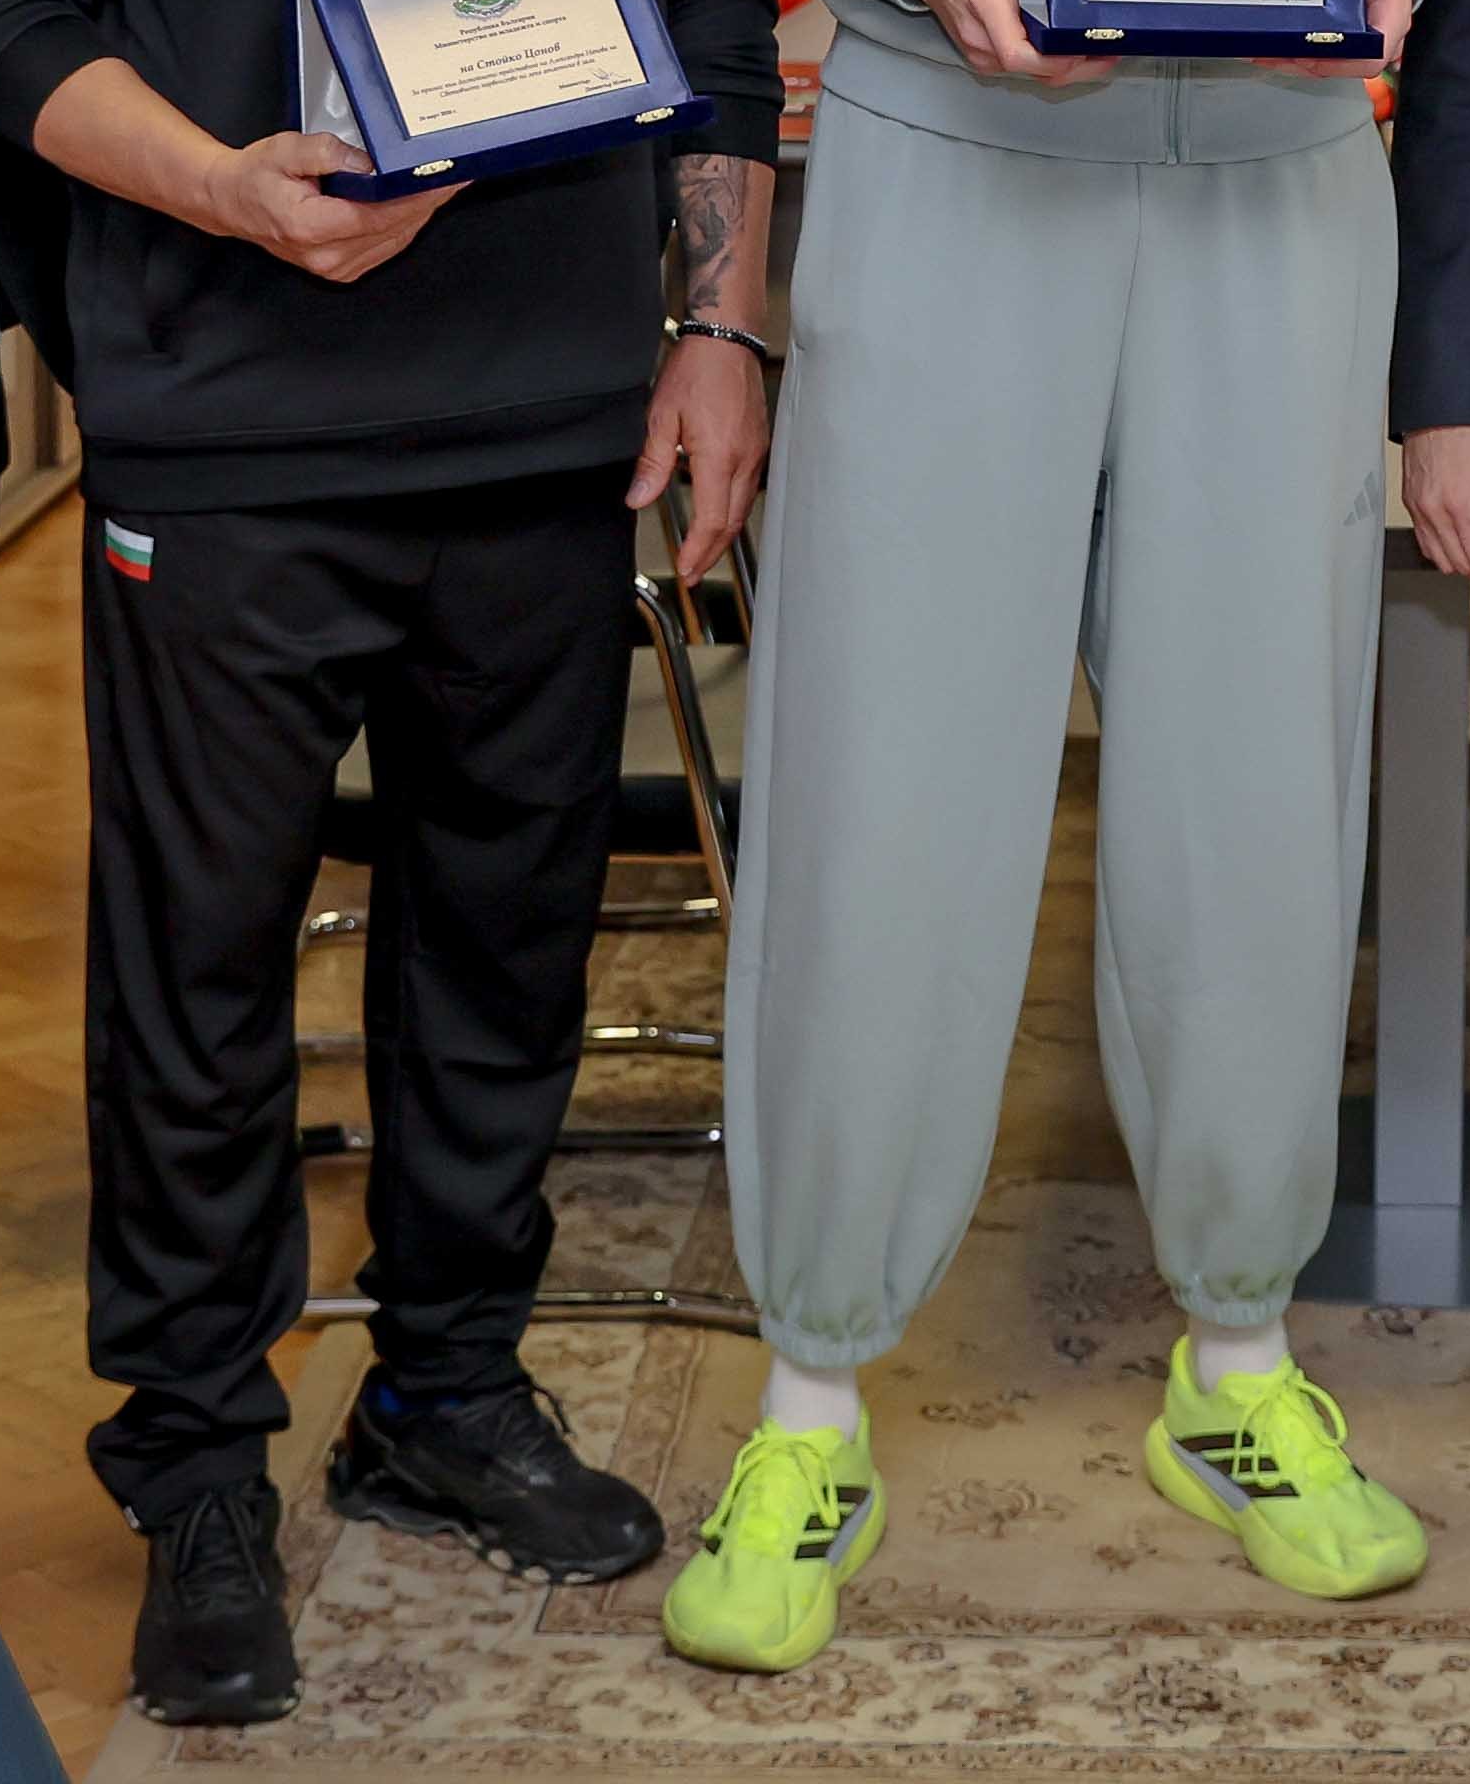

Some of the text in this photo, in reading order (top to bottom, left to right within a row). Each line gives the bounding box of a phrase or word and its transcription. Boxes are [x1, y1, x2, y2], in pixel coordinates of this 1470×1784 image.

[460, 64, 474, 73] на
[476, 53, 522, 69] Стойко
[524, 41, 560, 58] Цонов
